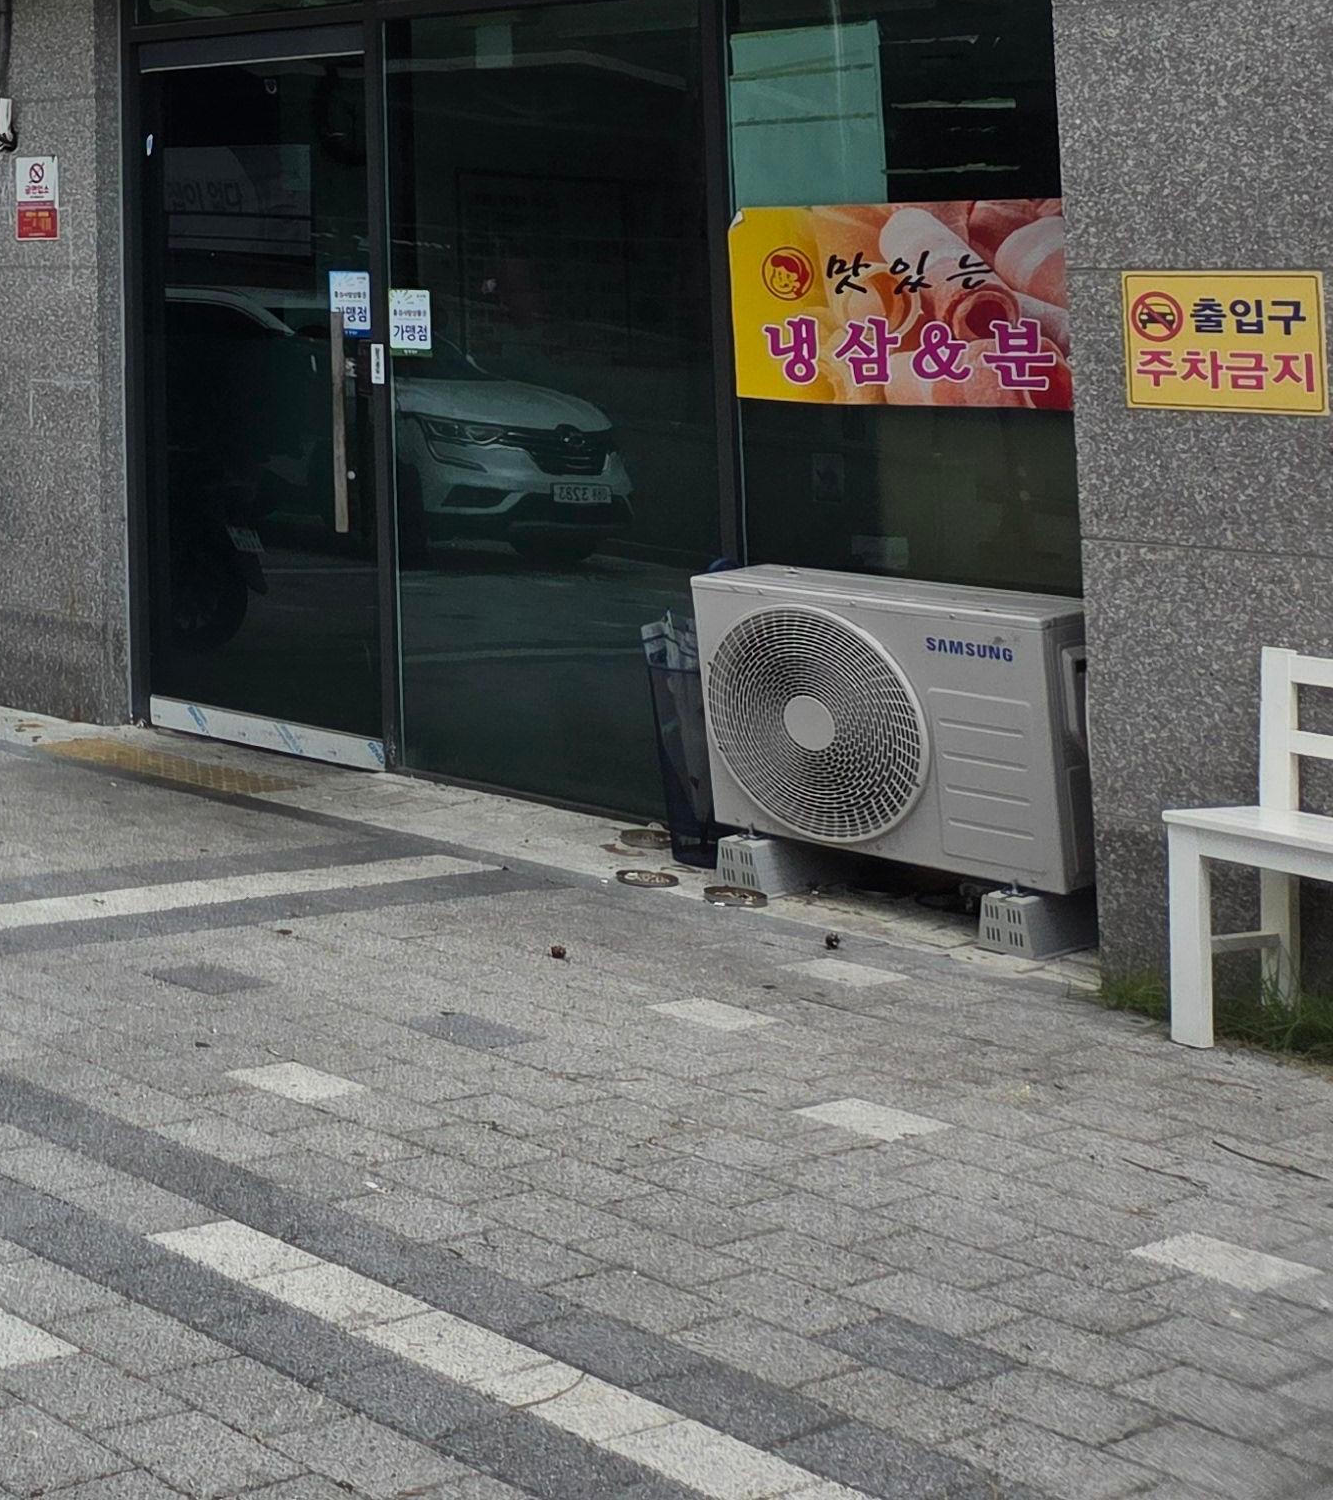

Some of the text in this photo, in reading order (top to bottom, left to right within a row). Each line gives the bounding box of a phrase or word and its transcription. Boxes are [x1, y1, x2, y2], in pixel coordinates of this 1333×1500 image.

[826, 250, 994, 296] 맛있는
[393, 323, 428, 342] 가맹점
[1188, 297, 1307, 336] 출입구
[764, 315, 1058, 391] 냉삼&분
[1135, 347, 1317, 394] 주차금지
[926, 636, 1014, 662] SAMSUNG
